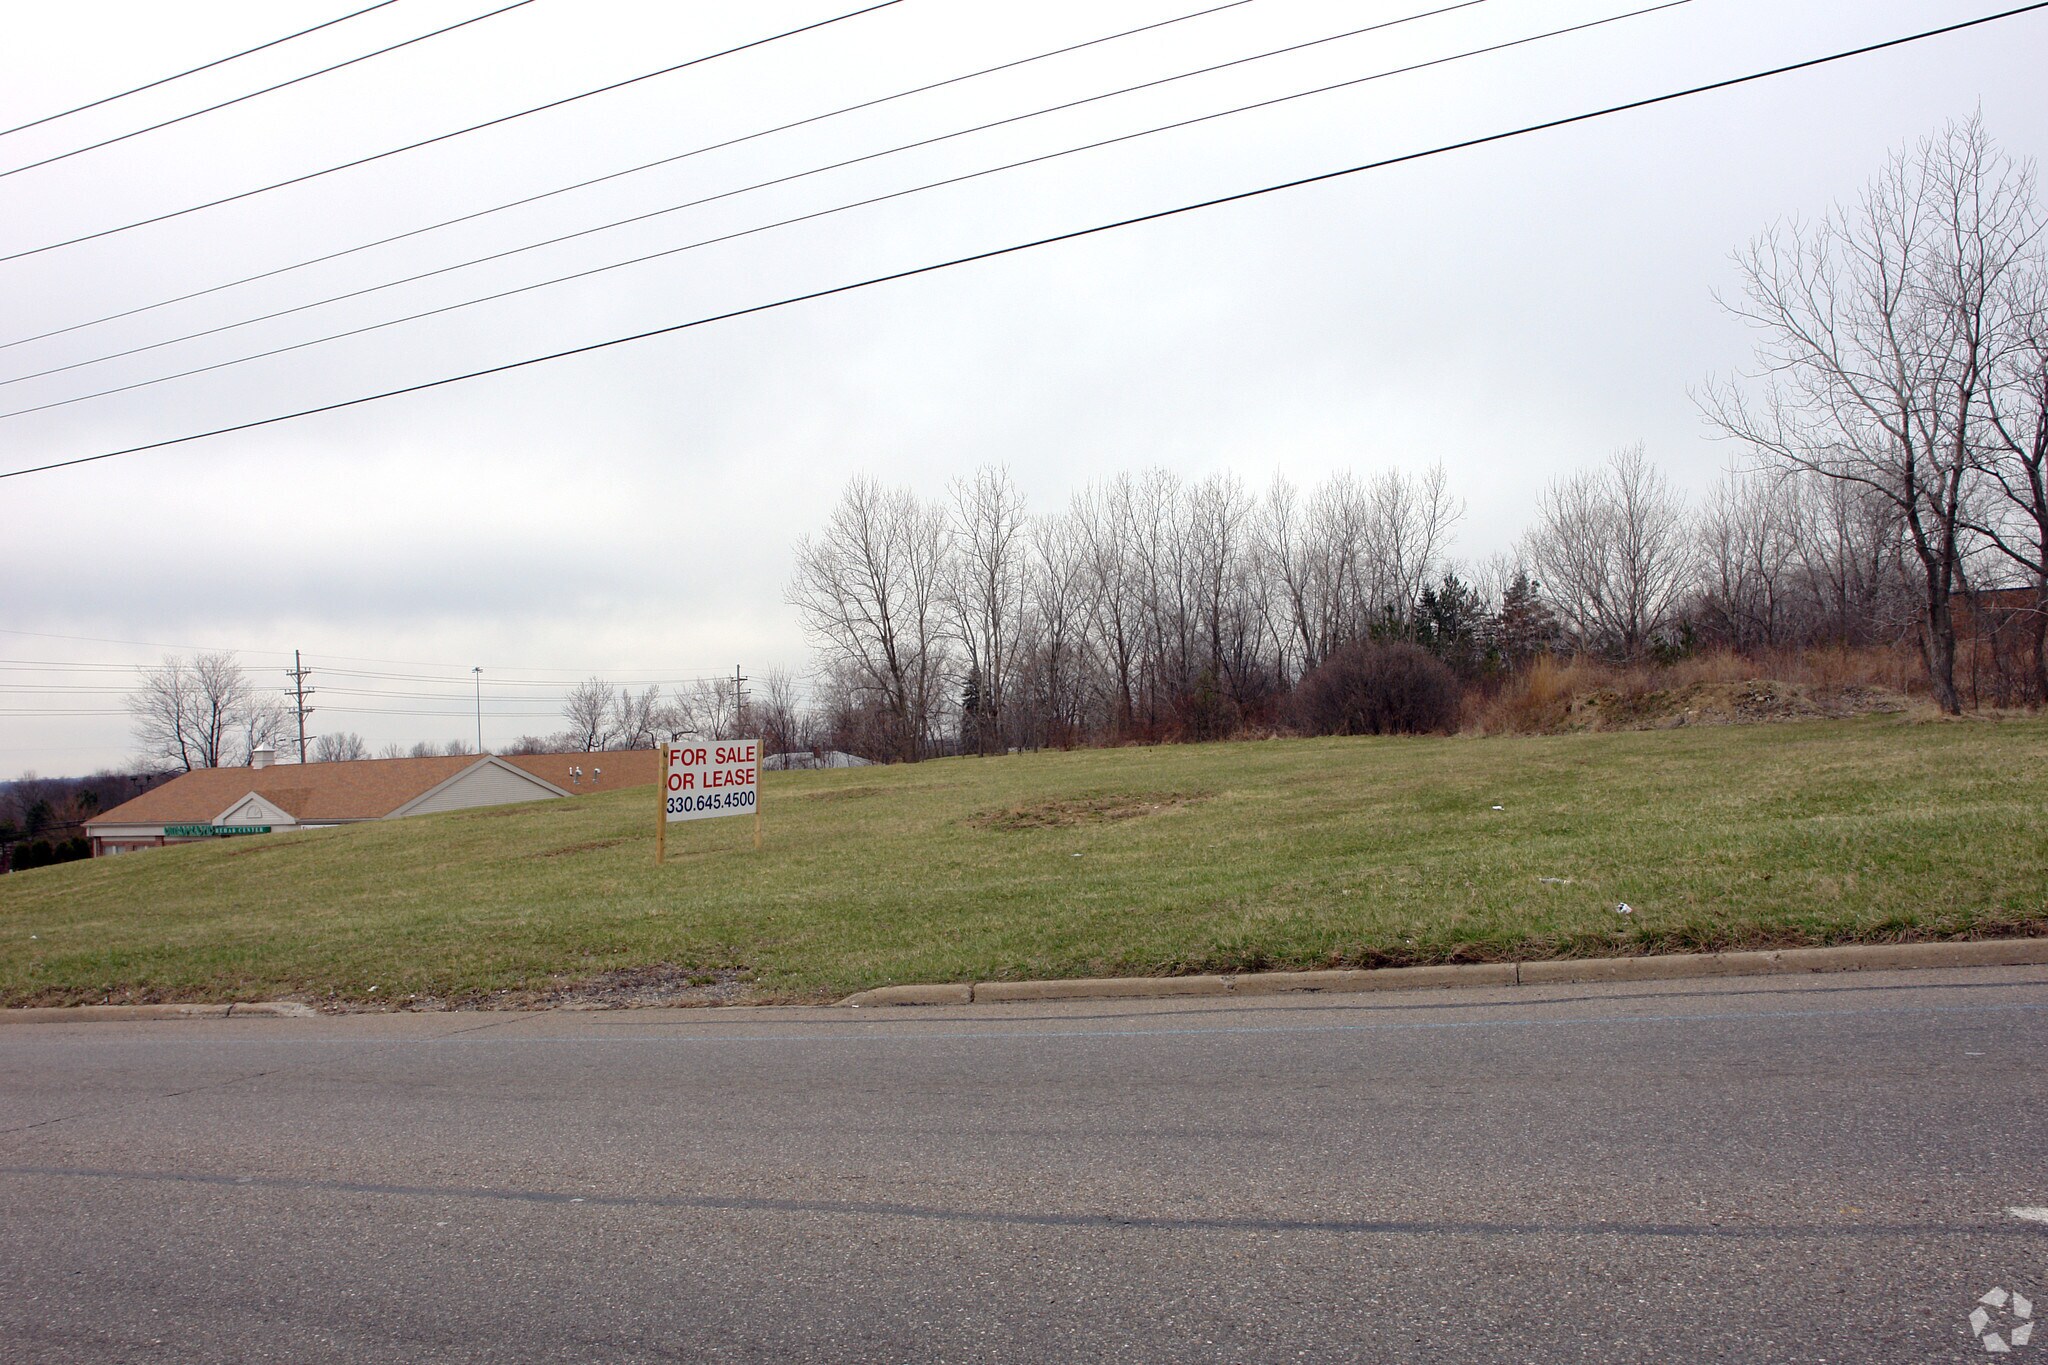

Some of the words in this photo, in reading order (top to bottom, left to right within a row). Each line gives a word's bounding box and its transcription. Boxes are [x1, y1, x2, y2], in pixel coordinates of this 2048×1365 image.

[669, 749, 707, 766] FOR
[715, 746, 755, 764] SALE
[667, 773, 695, 791] OR
[703, 768, 755, 788] LEASE
[666, 791, 755, 813] 330.645.4500
